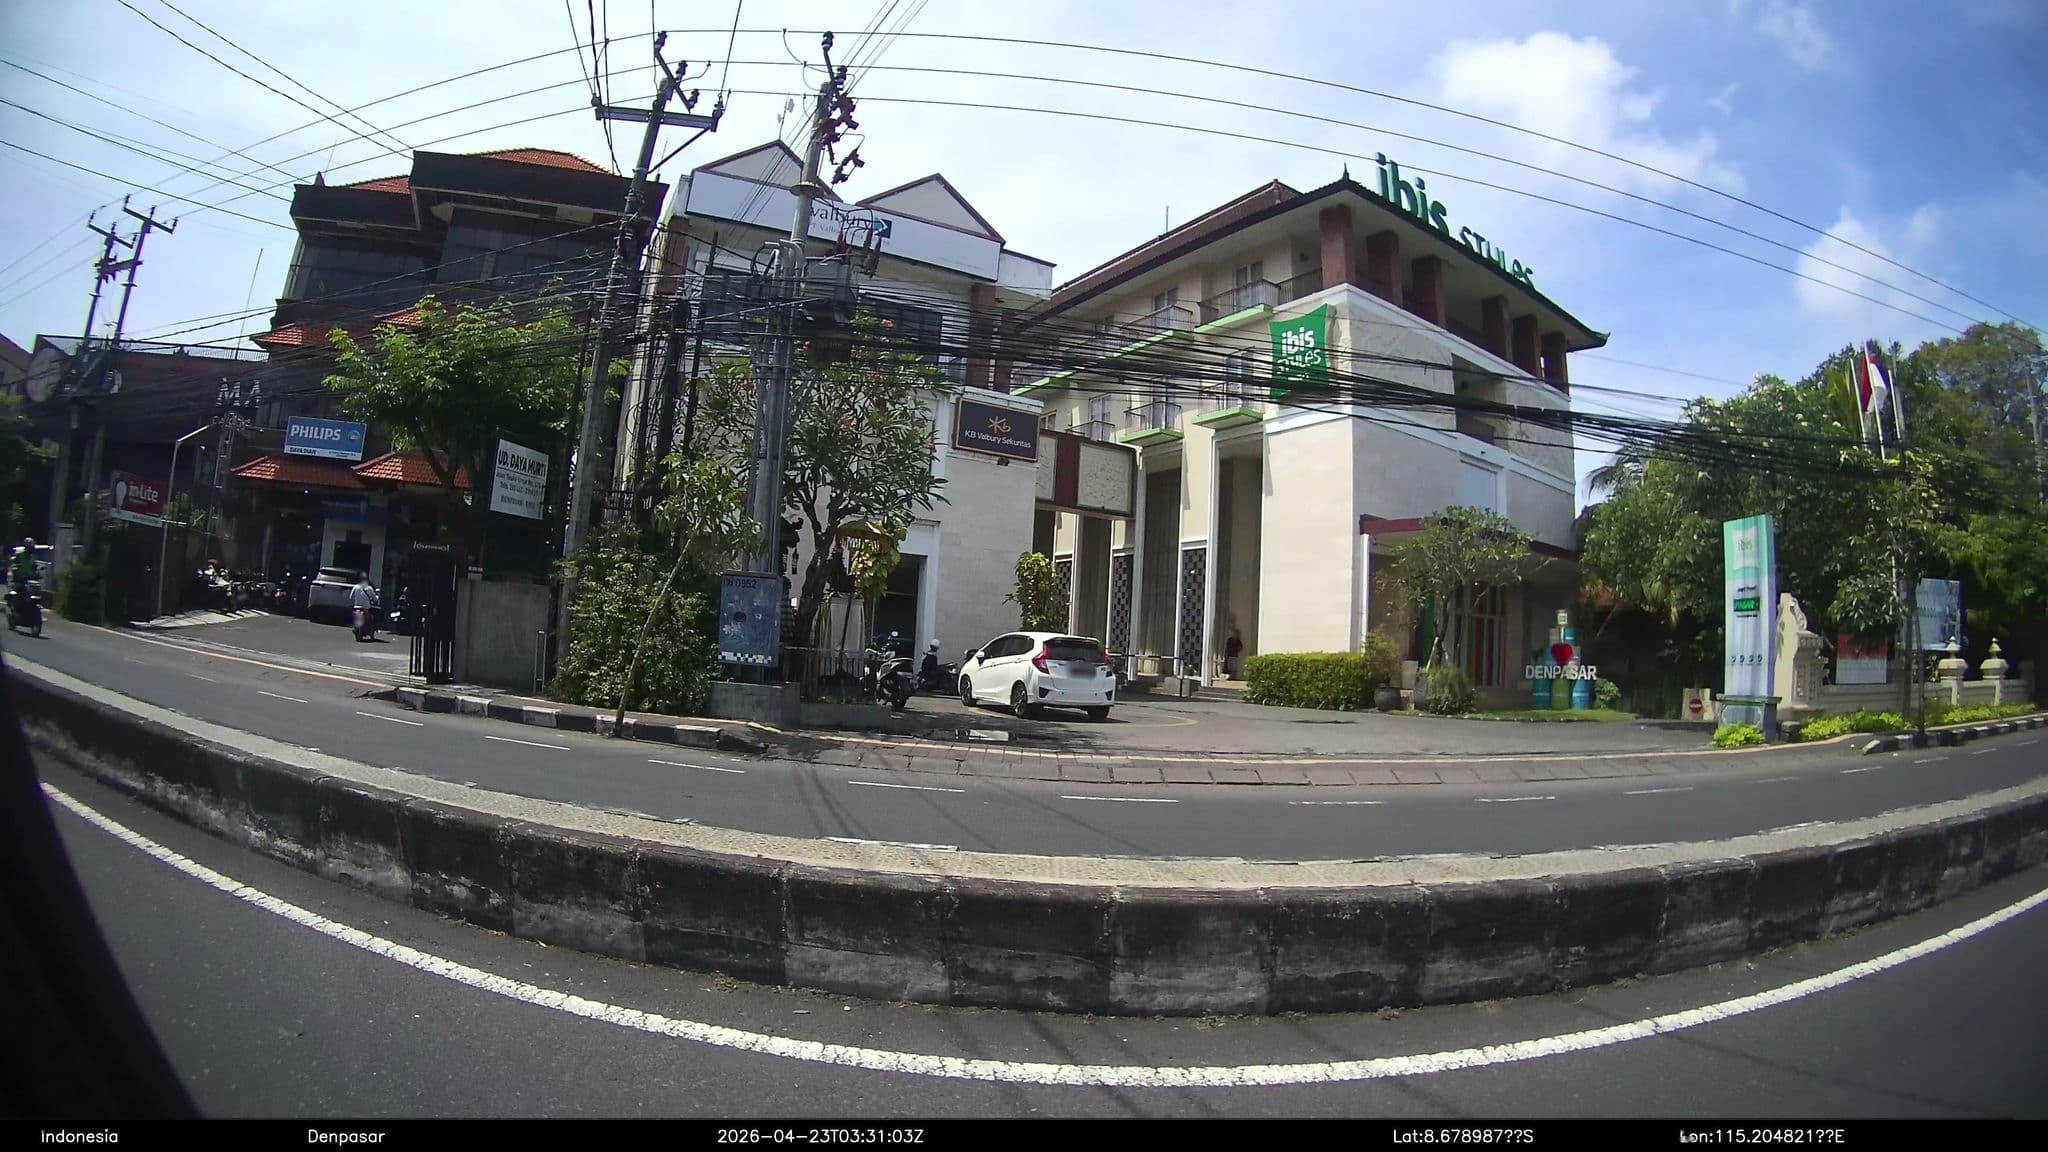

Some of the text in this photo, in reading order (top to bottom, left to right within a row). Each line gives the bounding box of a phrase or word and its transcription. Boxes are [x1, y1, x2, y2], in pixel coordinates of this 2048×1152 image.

[1375, 152, 1450, 234] ibis
[1281, 327, 1315, 356] ibis
[290, 424, 342, 441] PHILIPS
[964, 430, 1031, 448] KB Valbury Sekuritas
[509, 454, 527, 473] DAYA
[1525, 665, 1597, 680] DENPASAR
